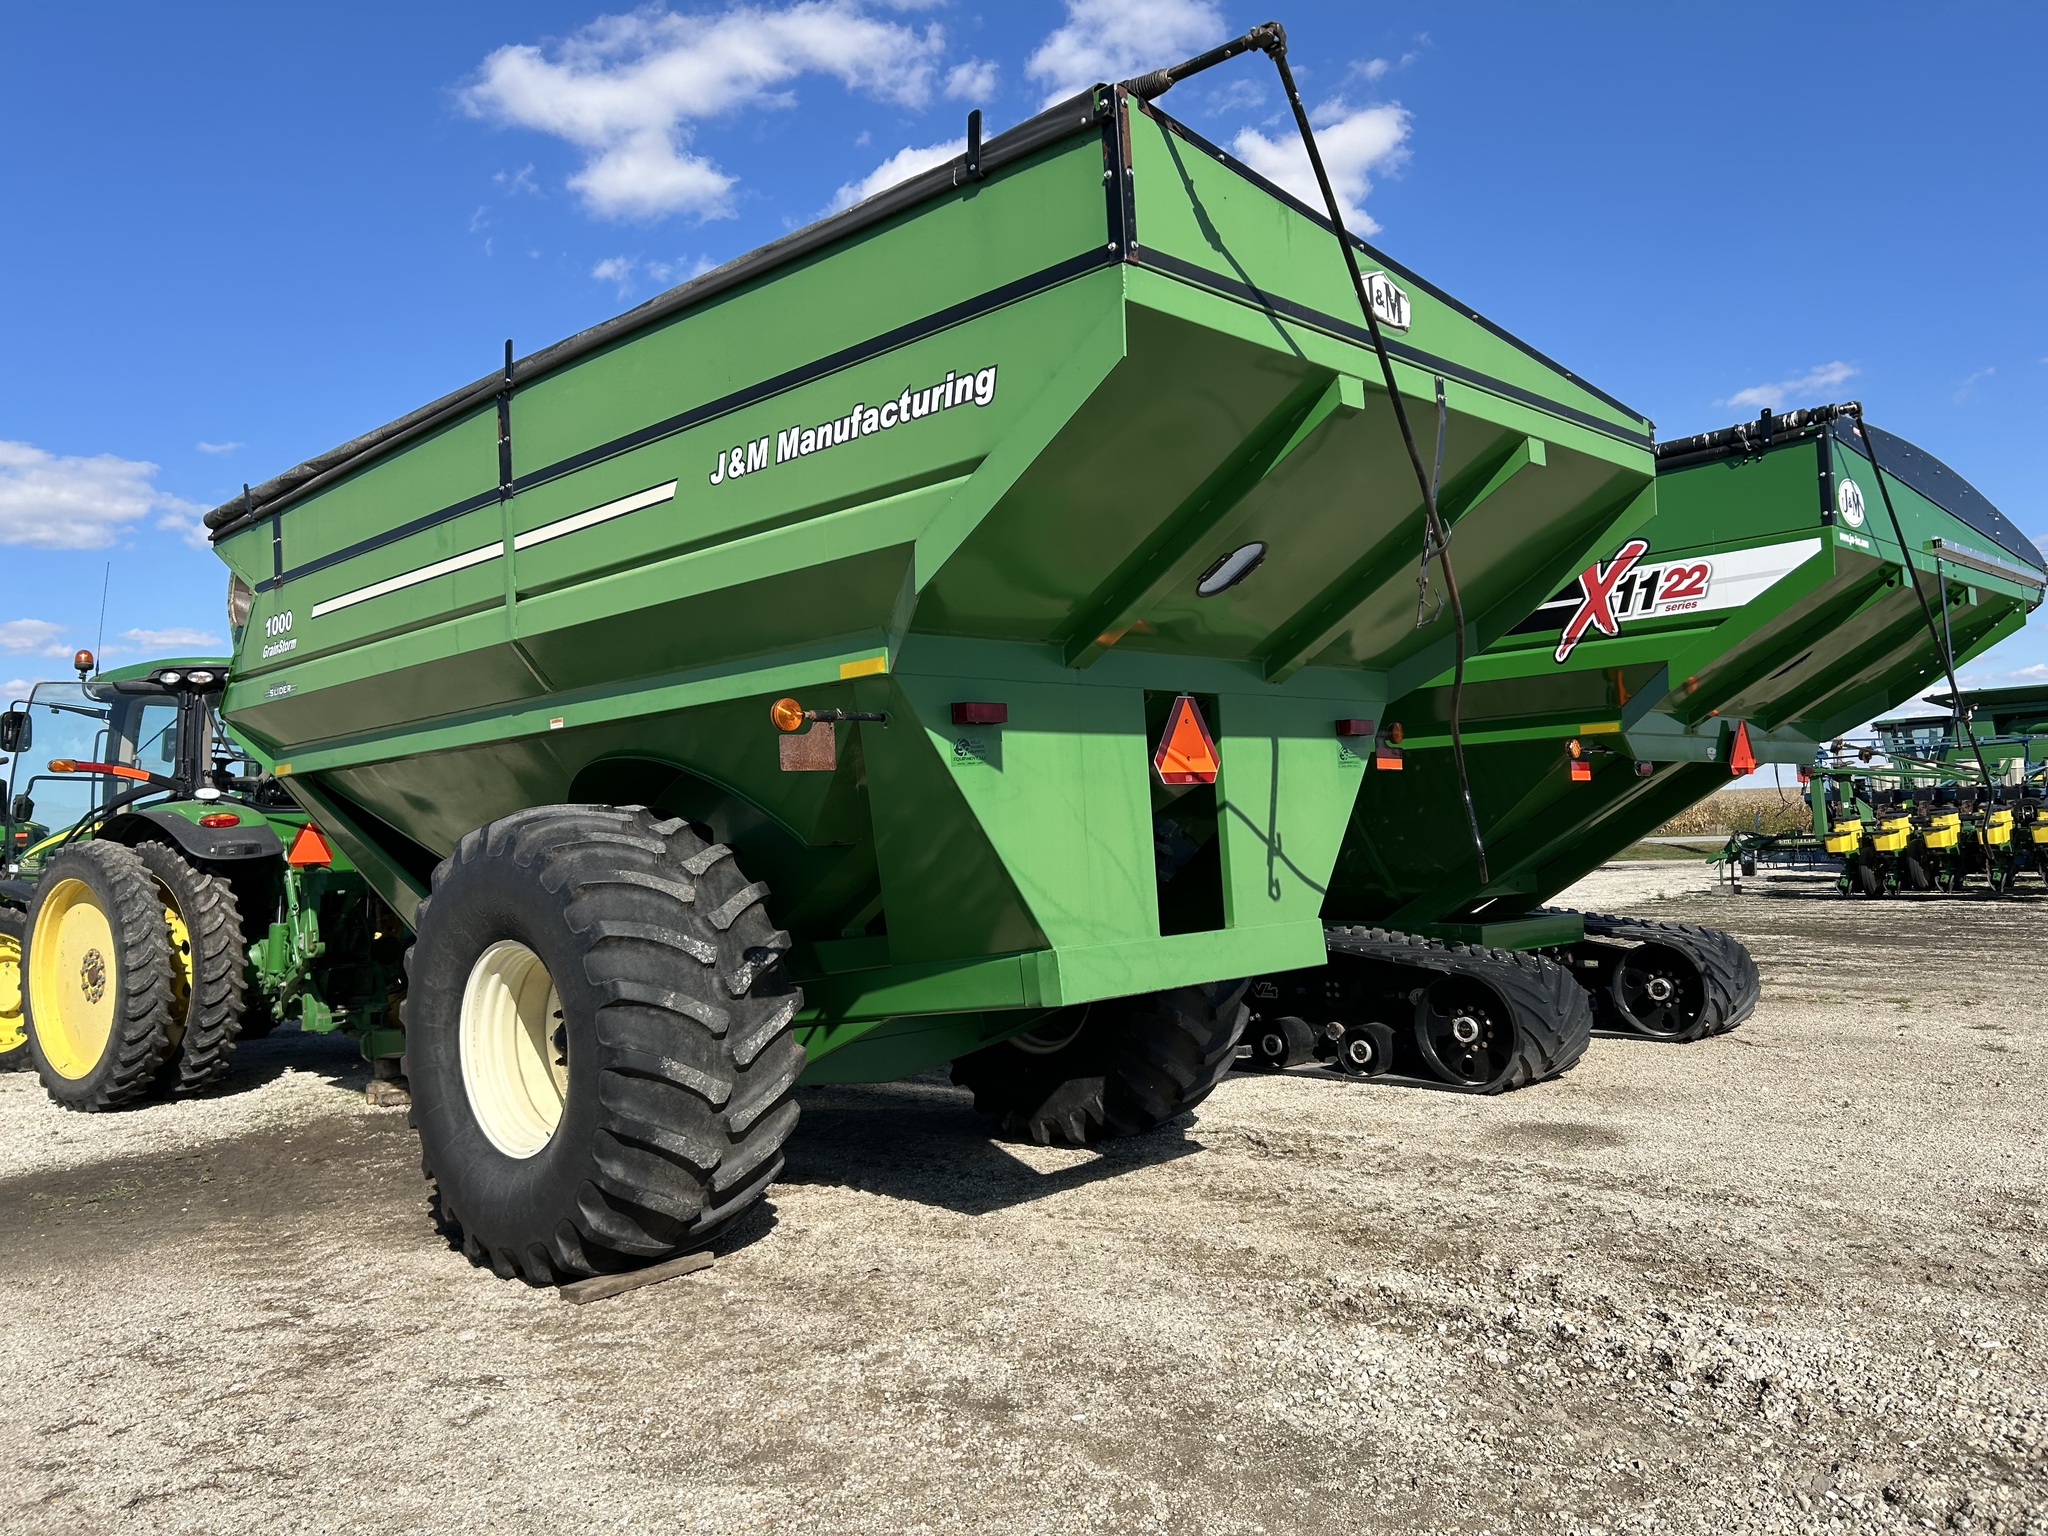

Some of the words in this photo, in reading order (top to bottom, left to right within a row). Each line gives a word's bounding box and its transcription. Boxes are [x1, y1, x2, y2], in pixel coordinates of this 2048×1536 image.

[709, 435, 769, 485] J&M
[775, 364, 998, 464] Manufacturing
[1841, 488, 1861, 518] J&M
[1664, 600, 1698, 612] series
[266, 611, 293, 637] 1000
[262, 638, 297, 659] GrainStorm
